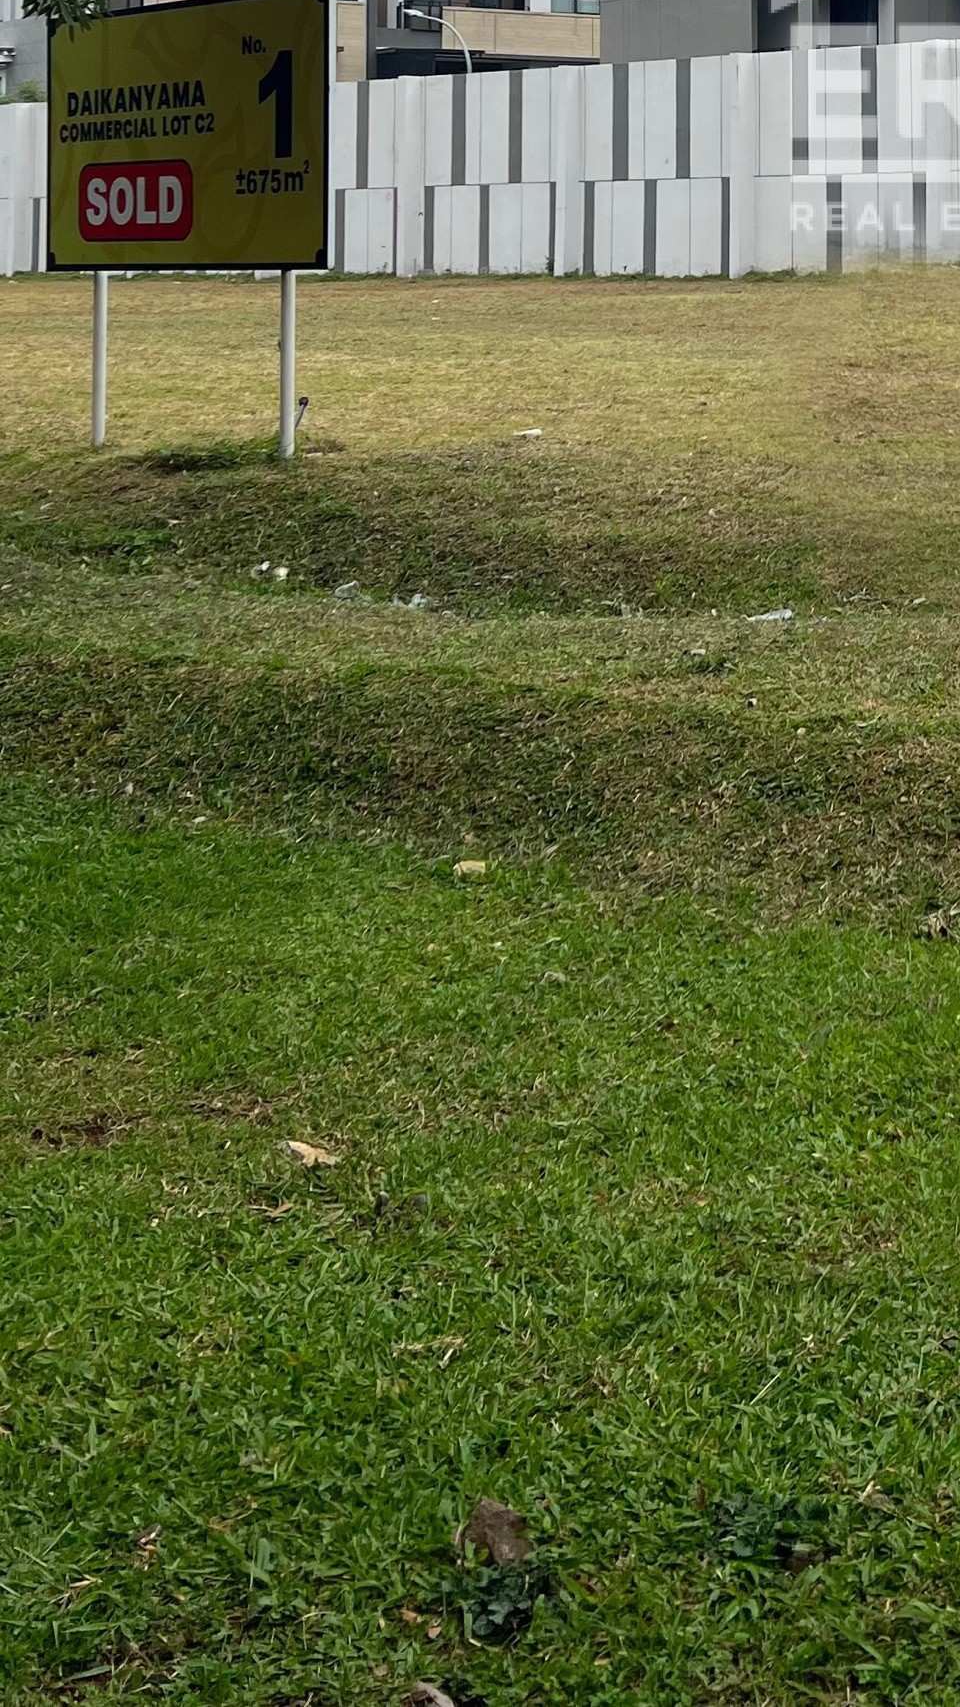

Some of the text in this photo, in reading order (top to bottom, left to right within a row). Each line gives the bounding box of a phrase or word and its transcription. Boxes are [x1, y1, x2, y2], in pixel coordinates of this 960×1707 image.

[241, 35, 266, 55] No.
[67, 80, 205, 117] DAIKANYAMA
[258, 49, 293, 159] 1
[59, 112, 215, 143] COMMERCIAL LOT C2
[86, 175, 183, 226] SOLD
